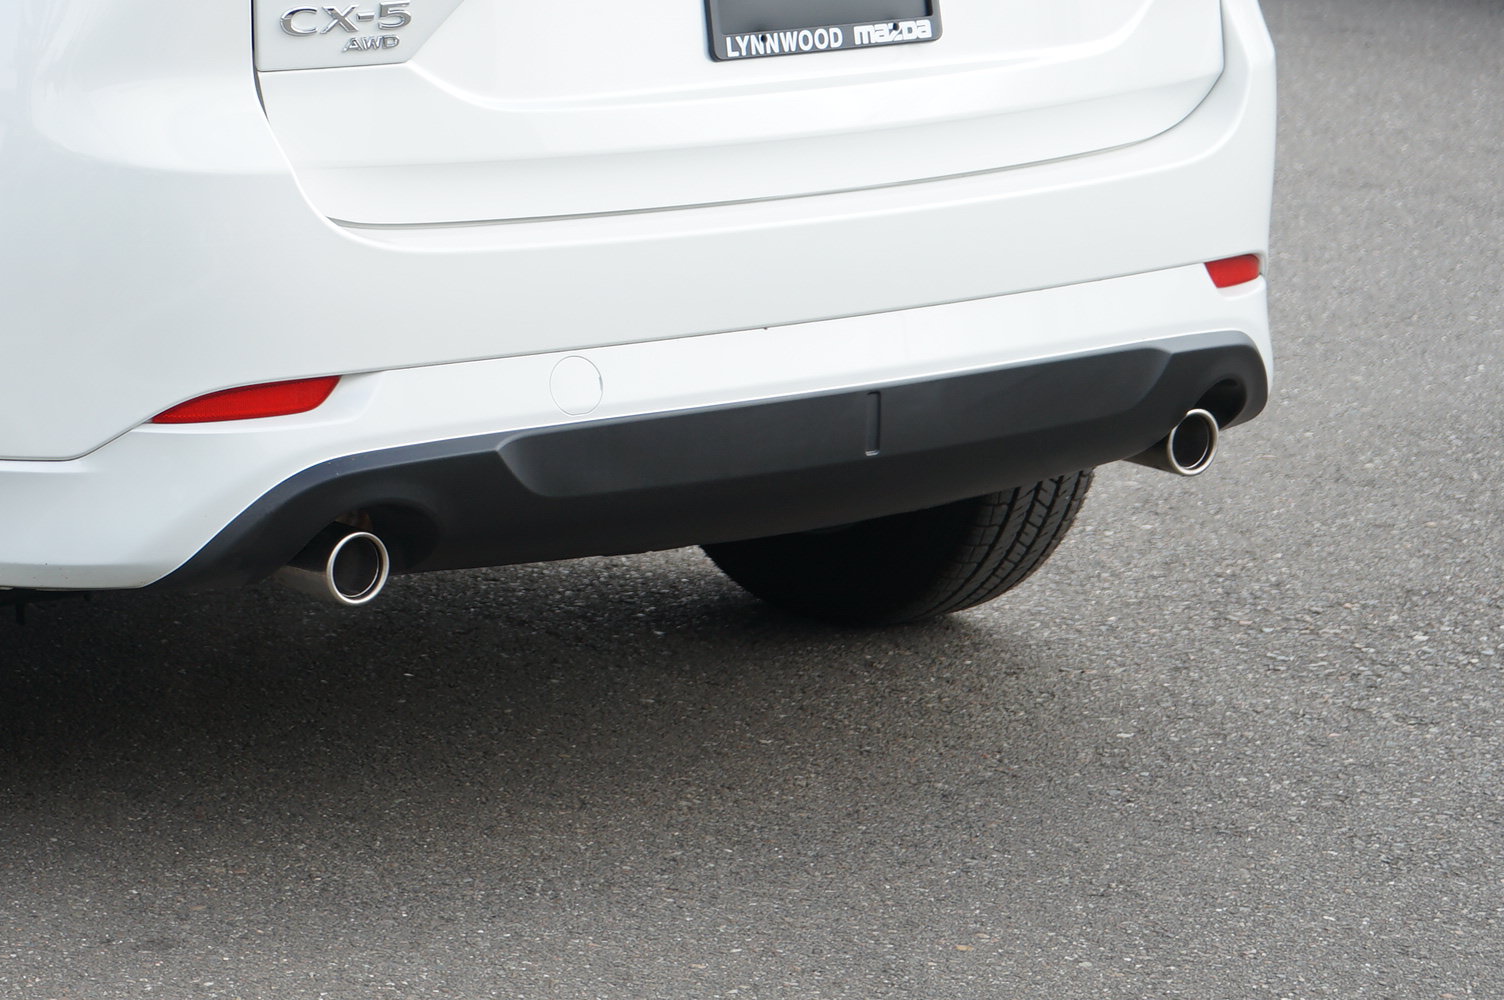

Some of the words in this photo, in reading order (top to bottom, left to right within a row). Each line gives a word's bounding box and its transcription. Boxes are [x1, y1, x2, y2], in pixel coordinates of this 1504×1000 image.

[280, 0, 412, 37] CX-5
[341, 34, 400, 53] AWD
[725, 27, 843, 57] LYNNWOOD
